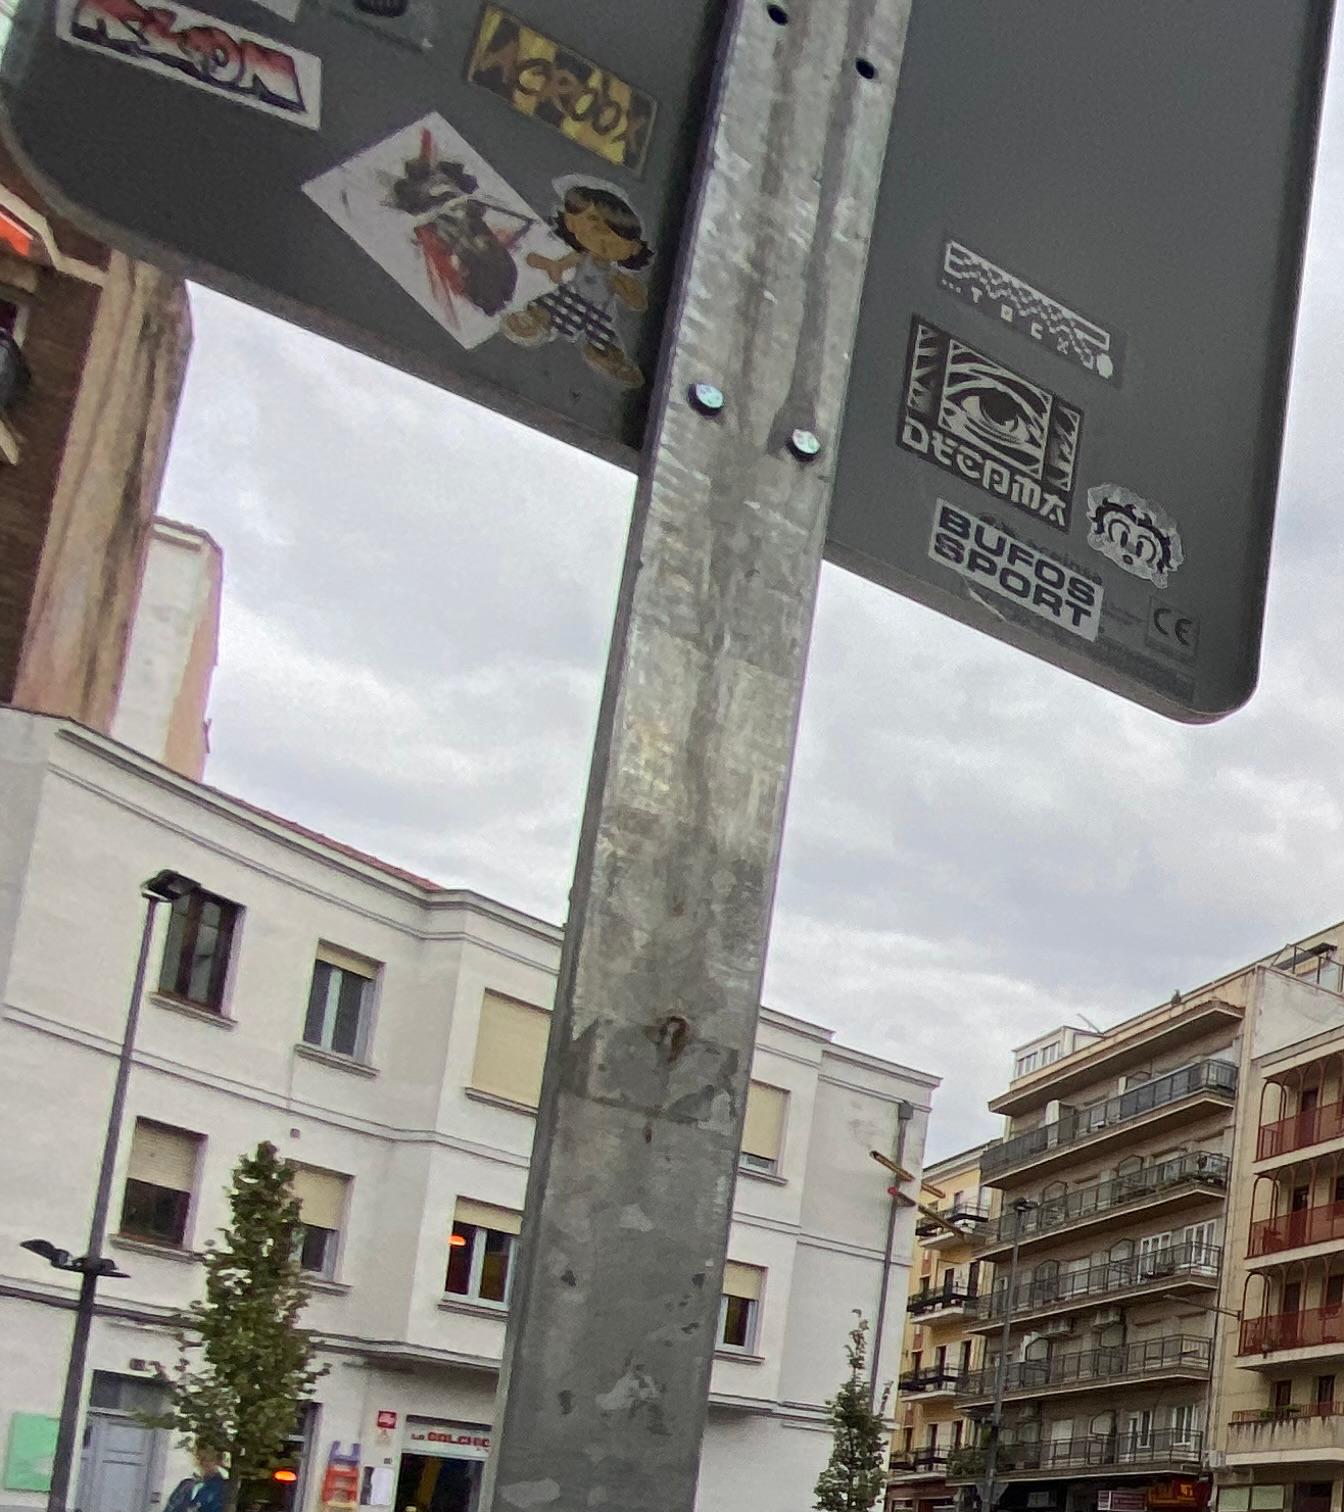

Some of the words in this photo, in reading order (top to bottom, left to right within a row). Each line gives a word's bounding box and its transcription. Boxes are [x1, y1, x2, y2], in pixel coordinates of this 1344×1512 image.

[934, 532, 1092, 627] SPORT
[937, 505, 1096, 606] BUFOS
[1153, 606, 1193, 647] CE
